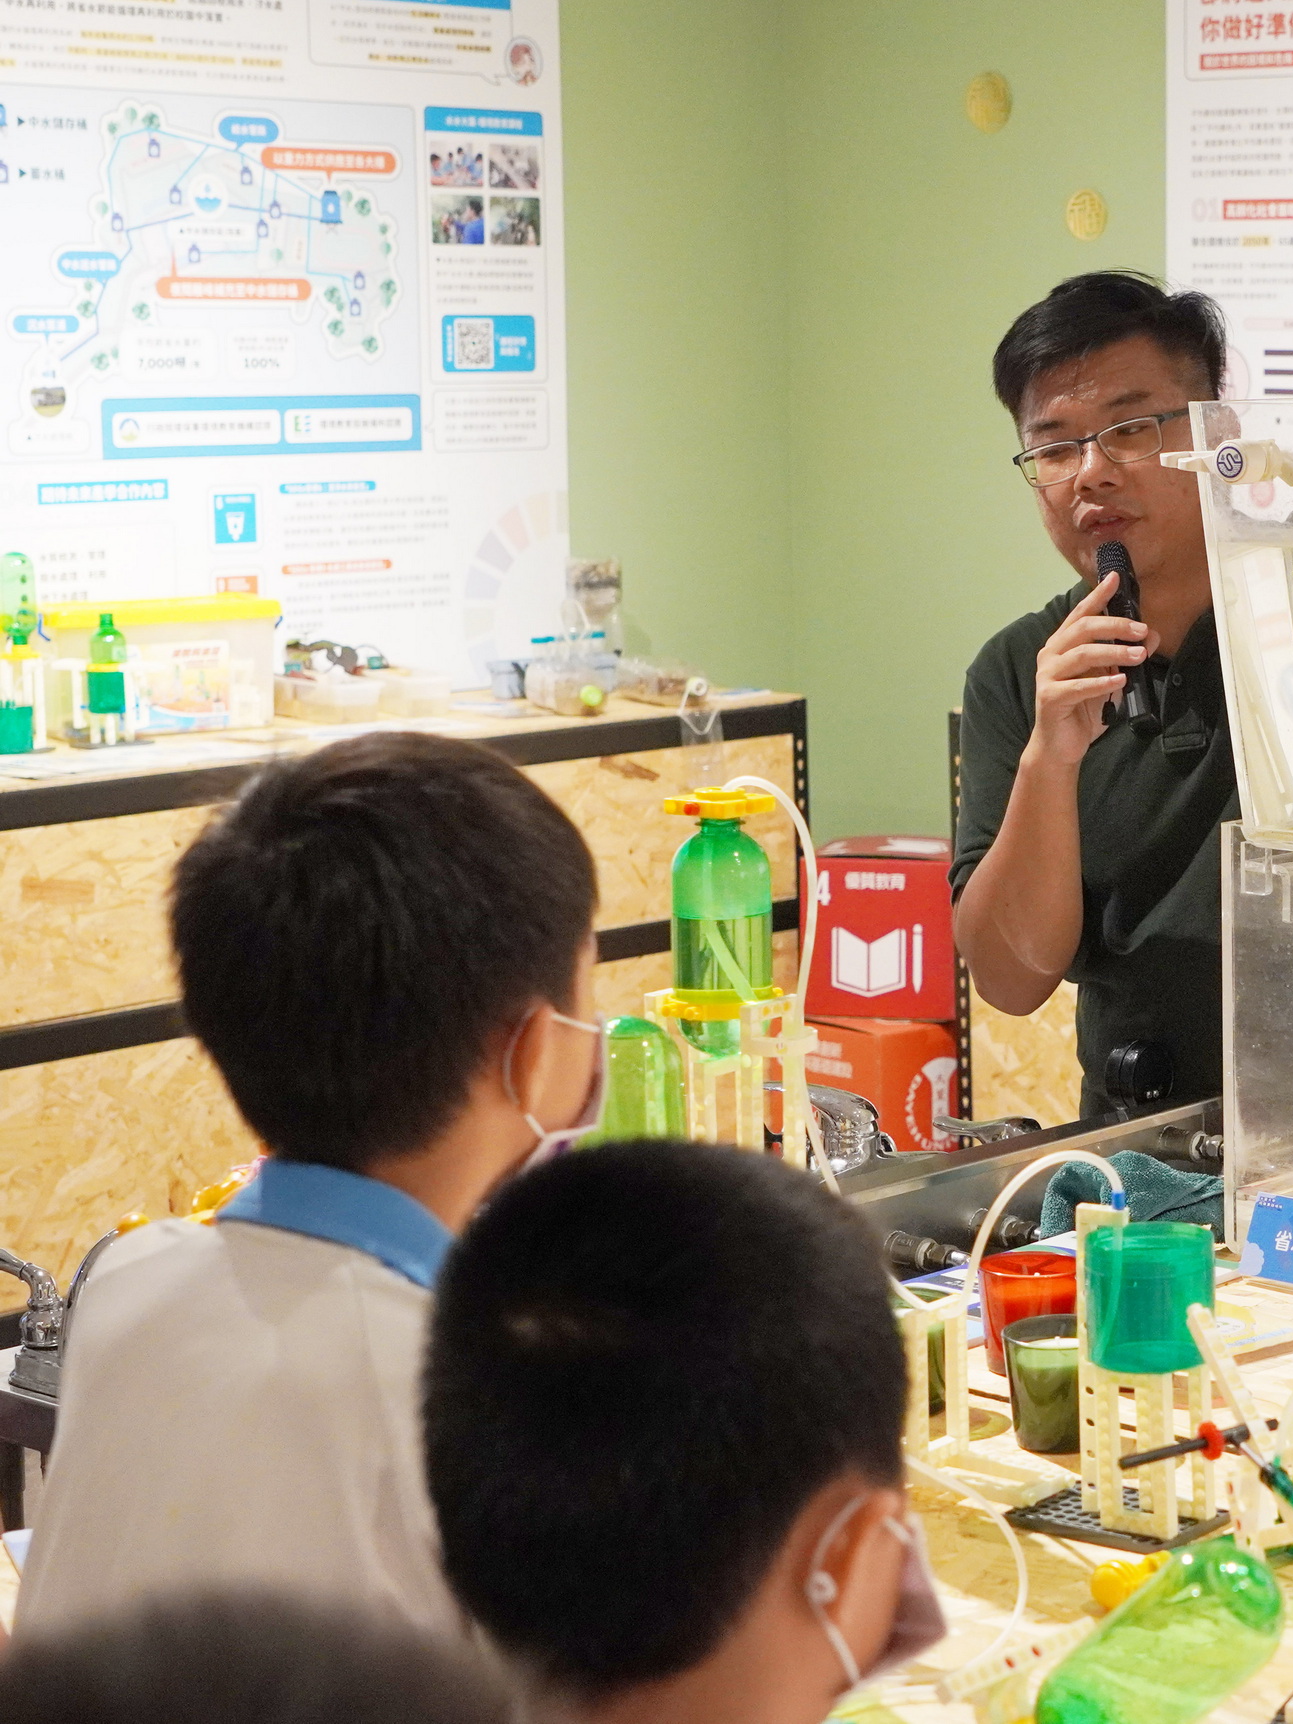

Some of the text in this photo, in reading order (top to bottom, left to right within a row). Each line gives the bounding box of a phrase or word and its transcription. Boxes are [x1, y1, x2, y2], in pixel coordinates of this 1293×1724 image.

[244, 357, 279, 369] 100%
[815, 871, 906, 906] 4 優質教育
